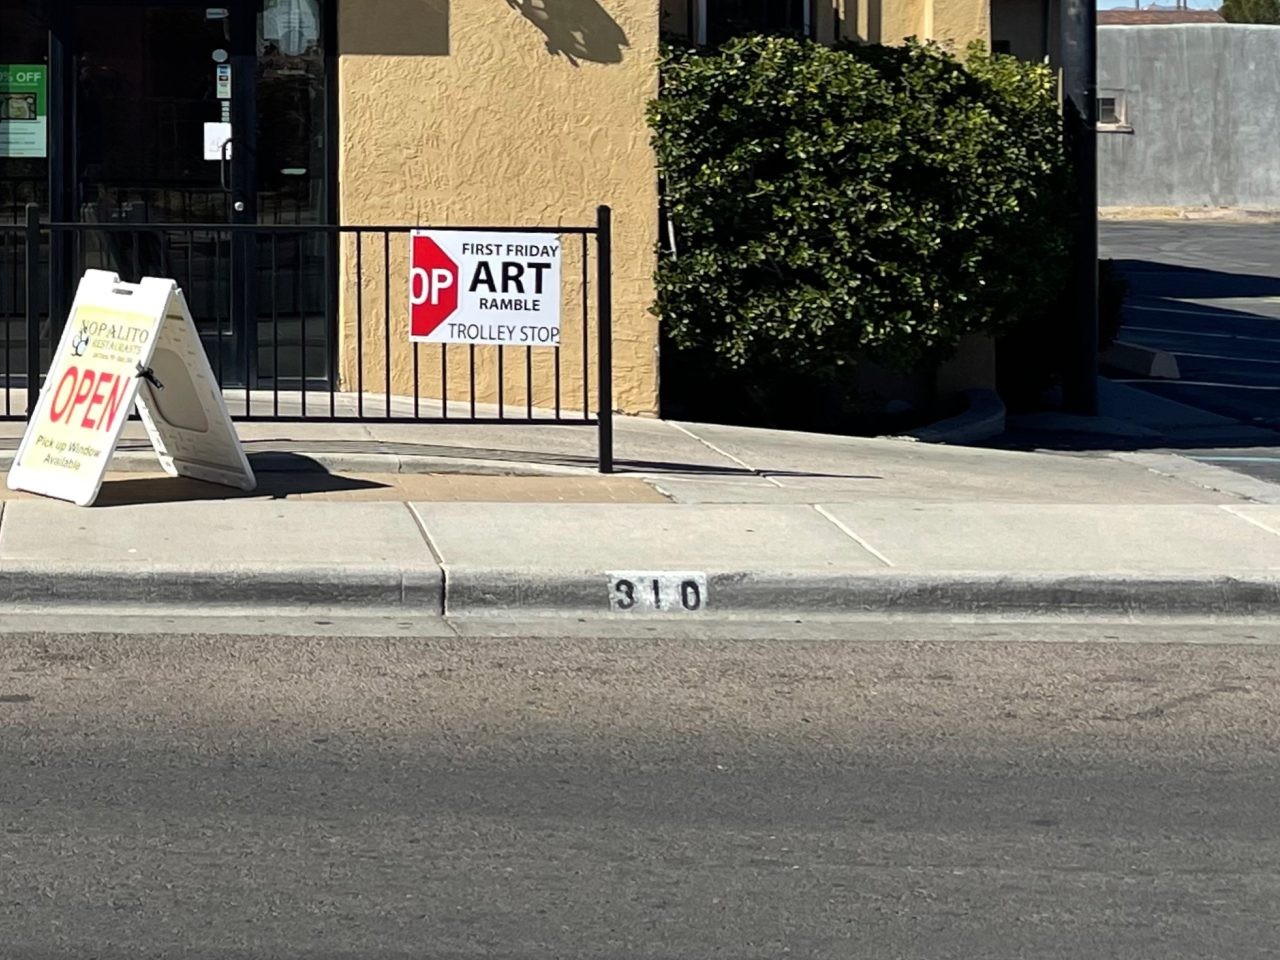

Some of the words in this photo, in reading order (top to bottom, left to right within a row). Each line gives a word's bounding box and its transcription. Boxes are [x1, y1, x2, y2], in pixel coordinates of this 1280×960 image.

[16, 71, 42, 82] OFF
[462, 243, 503, 256] FIRST
[506, 244, 559, 257] FRIDAY
[468, 260, 552, 294] ART
[479, 297, 541, 312] RAMBLE
[82, 319, 149, 344] NOPALITO
[448, 323, 517, 341] TROLLEY
[520, 326, 560, 343] STOP
[49, 366, 131, 433] OPEN
[36, 434, 54, 448] Pick
[55, 441, 67, 453] up
[68, 441, 101, 457] Window
[43, 453, 81, 470] Available
[615, 579, 701, 611] 310
